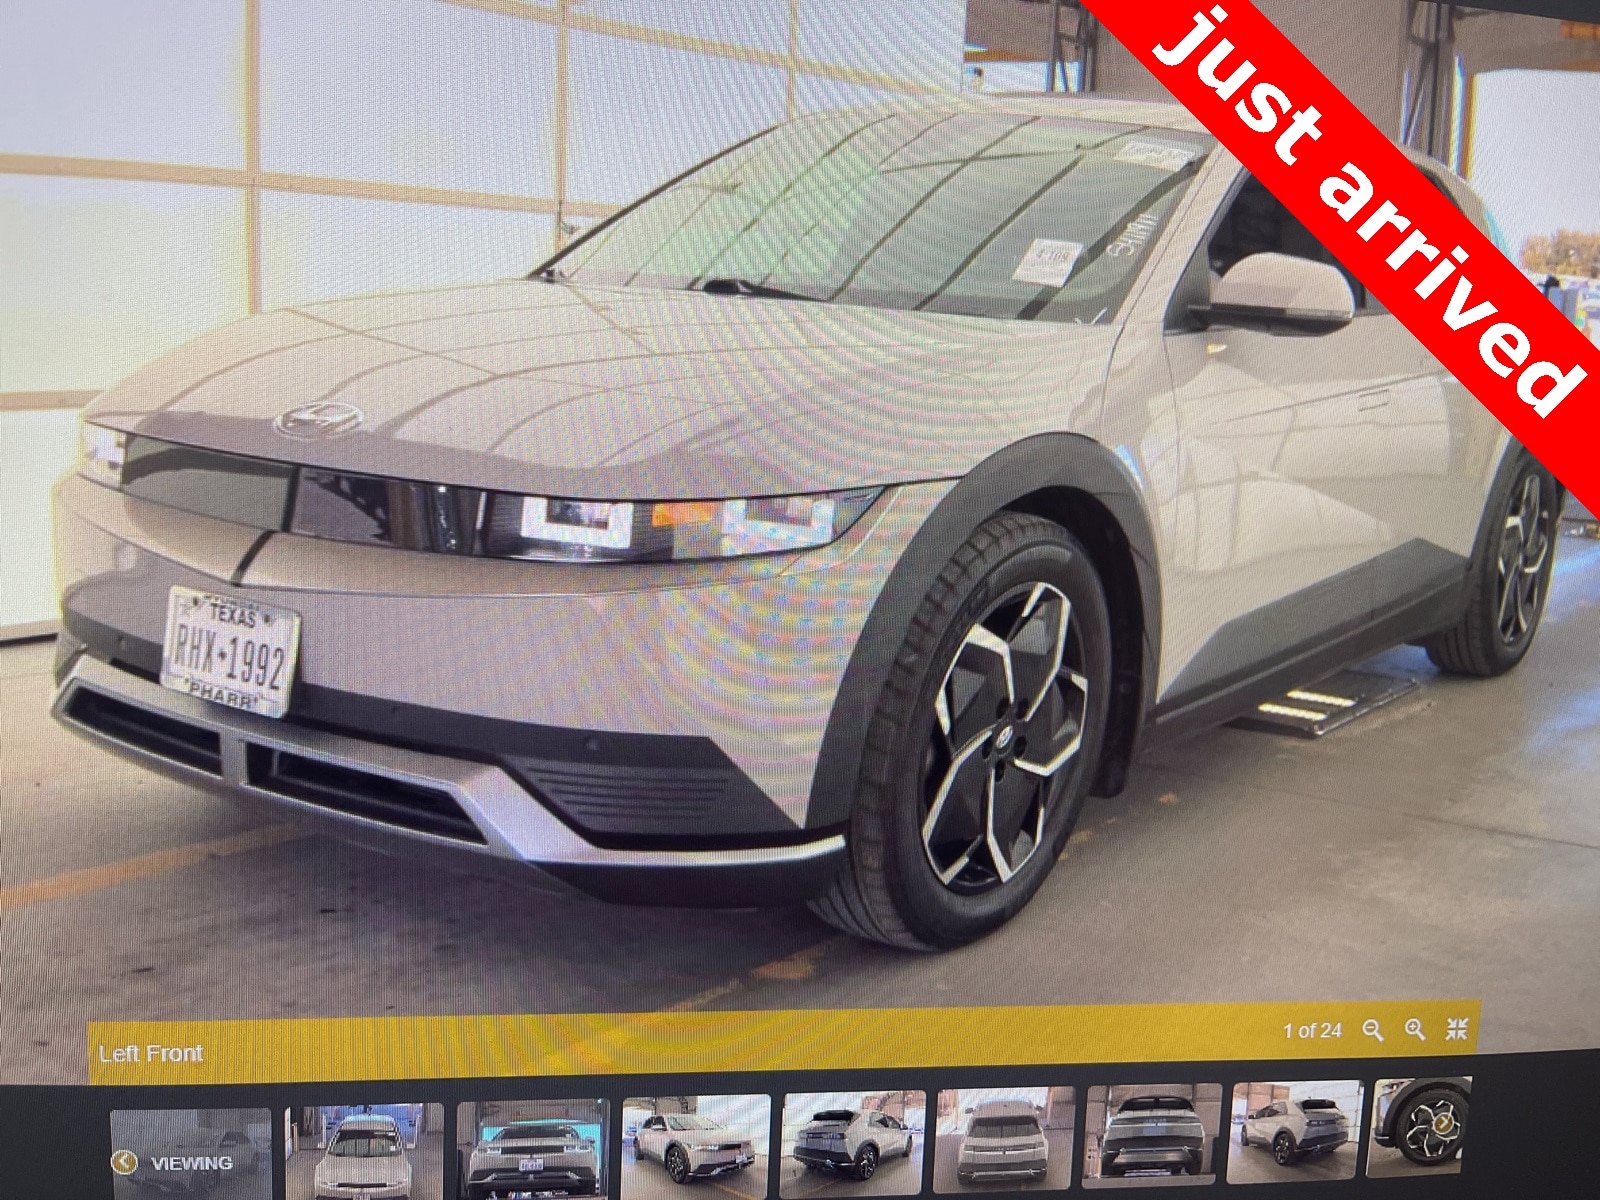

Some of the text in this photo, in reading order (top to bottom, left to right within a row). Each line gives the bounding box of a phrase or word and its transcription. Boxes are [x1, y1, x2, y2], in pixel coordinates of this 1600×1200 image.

[210, 603, 257, 628] TEXAS
[1284, 1022, 1343, 1039] 1 of 24
[99, 1044, 204, 1062] Left Front
[151, 1156, 233, 1171] VIEWING
